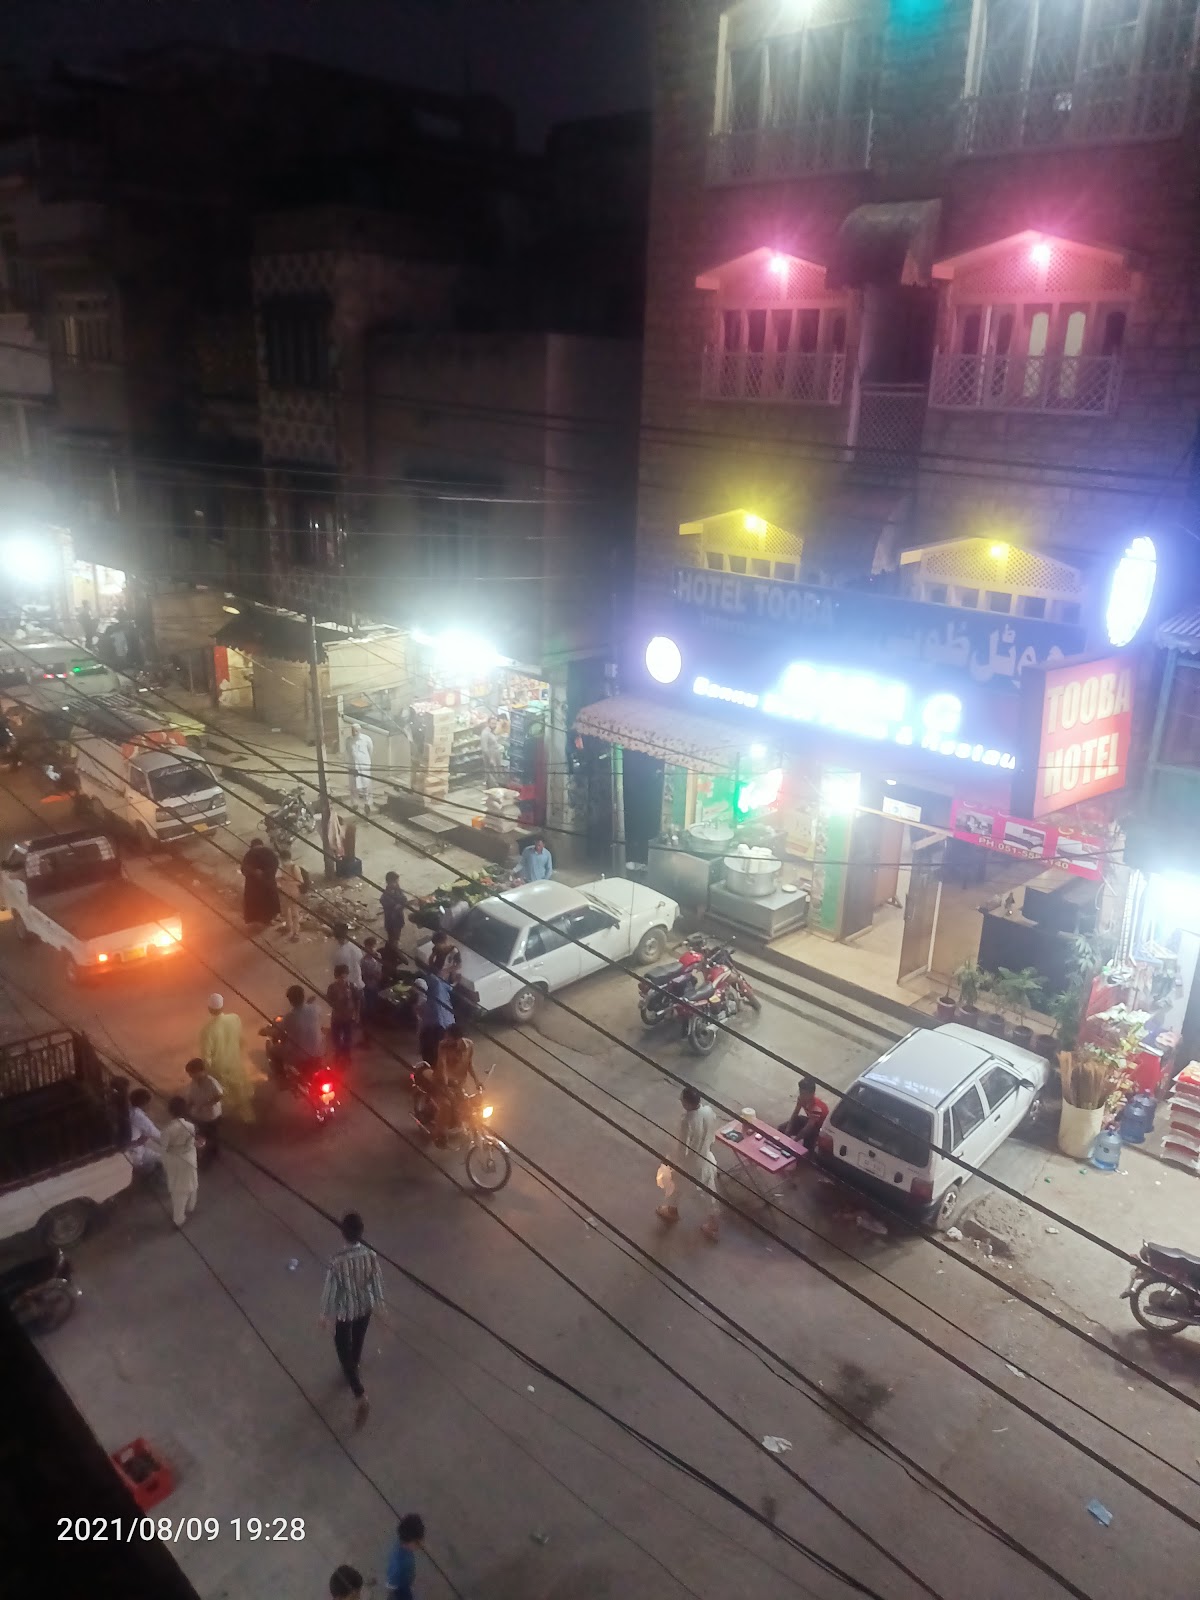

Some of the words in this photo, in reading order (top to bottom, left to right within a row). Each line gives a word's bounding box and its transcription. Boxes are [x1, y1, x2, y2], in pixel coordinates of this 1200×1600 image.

[678, 571, 747, 612] HOTEL
[753, 583, 834, 628] TOOBA
[1048, 668, 1131, 735] TOOBA
[1043, 732, 1120, 799] HOTEL
